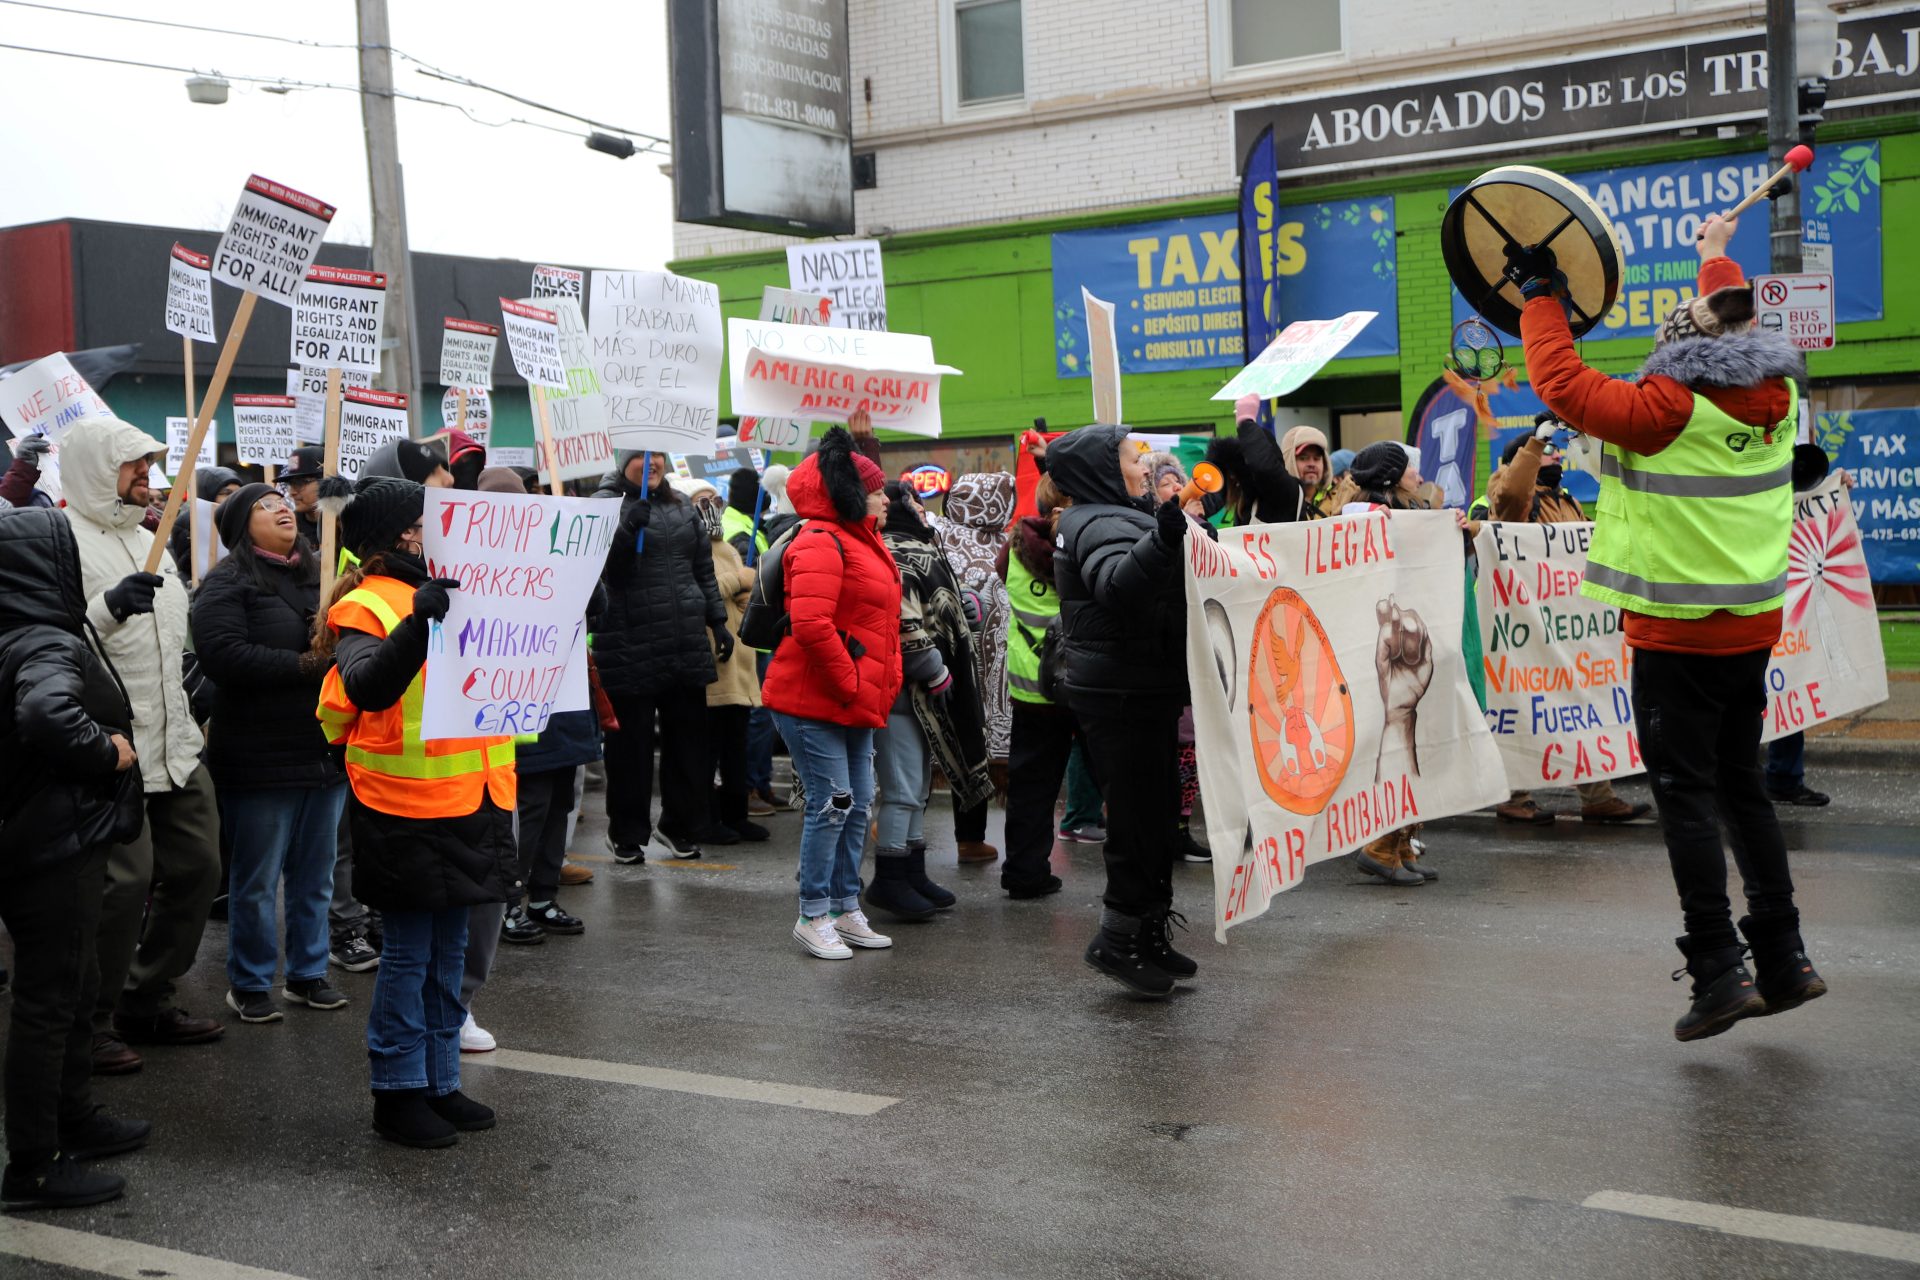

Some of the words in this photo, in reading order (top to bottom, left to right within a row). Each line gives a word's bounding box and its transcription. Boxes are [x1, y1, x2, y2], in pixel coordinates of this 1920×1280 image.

[786, 10, 832, 39] EXTRAS
[769, 28, 829, 59] PAGADAS
[733, 52, 842, 94] DISCRIMINACION
[1300, 81, 1546, 151] ABOGADOS
[1562, 80, 1612, 111] DE
[1620, 70, 1687, 104] LOS
[1703, 27, 1920, 97] TRBAJ
[742, 91, 836, 130] 773-831-8000
[1582, 164, 1769, 218] ANGLISH
[237, 203, 318, 244] IMMIGRANT
[230, 222, 278, 250] RIGHTS
[281, 242, 309, 261] AND
[224, 238, 303, 275] LEGALIZATION
[801, 248, 878, 283] NADIE
[1128, 221, 1307, 289] TAXS
[218, 253, 255, 281] FOR
[258, 270, 297, 297] ALL!
[319, 270, 335, 278] WITH
[336, 271, 372, 283] PALESTINE
[534, 266, 560, 277] FIGHT
[561, 271, 581, 281] FOR
[534, 274, 580, 292] MLK'S
[1654, 260, 1698, 282] FAMIL
[169, 283, 190, 300] RIGHTS
[193, 293, 208, 305] AND
[604, 274, 636, 299] MI
[1143, 289, 1195, 312] SERVICIO
[1198, 286, 1241, 306] ELECTR
[168, 297, 209, 318] LEGALIZATION
[296, 292, 378, 314] IMMIGRANT
[1789, 310, 1819, 322] BUS
[168, 310, 186, 328] FOR
[189, 317, 211, 335] ALL!
[296, 310, 343, 327] RIGHTS
[348, 317, 377, 331] AND
[612, 304, 698, 334] TRABAJA
[1144, 312, 1200, 336] DEPÓSITO
[1202, 310, 1242, 331] DIRECT
[1790, 323, 1827, 335] STOP
[296, 326, 376, 345] LEGALIZATION
[444, 337, 491, 352] IMMIGRANT
[507, 321, 555, 344] IMMIGRANT
[746, 329, 784, 350] NO
[803, 334, 867, 356] ONE
[295, 340, 330, 360] FOR
[337, 345, 375, 365] ALL!
[443, 349, 471, 360] RIGHTS
[473, 354, 489, 363] AND
[509, 336, 537, 352] RIGHTS
[539, 345, 557, 357] AND
[512, 349, 560, 368] LEGALIZATION
[593, 330, 636, 357] MÁS
[649, 339, 699, 364] DURO
[1145, 339, 1205, 361] CONSULTA
[1208, 338, 1216, 356] Y
[303, 367, 368, 382] LEGAATION
[442, 359, 489, 372] LEGALIZATION
[442, 369, 462, 383] FOR
[466, 372, 488, 385] ALL!
[516, 360, 535, 378] FOR
[539, 367, 563, 384] ALL!
[603, 361, 647, 388] QUE
[659, 367, 687, 389] EL
[749, 358, 854, 393] AMERICA
[863, 376, 929, 404] GREAT
[17, 389, 52, 423] WE
[55, 401, 87, 429] HAVE
[444, 398, 486, 410] DEORT
[552, 398, 579, 431] NOT
[237, 414, 293, 425] IMMIGRANT
[238, 426, 271, 435] RIGHTS
[275, 427, 293, 436] AND
[343, 412, 403, 432] IMMIGRANT
[754, 416, 800, 446] KIDS
[239, 437, 293, 446] LEGALIZATION
[341, 444, 376, 456] LEGALIZ
[342, 431, 377, 444] RIGHTS
[1859, 433, 1907, 458] TAX
[240, 446, 265, 459] FOR
[1871, 494, 1920, 522] MÁS
[439, 500, 543, 553] TRUMP
[549, 509, 620, 558] LATIN
[1492, 523, 1527, 561] EL
[1541, 523, 1596, 559] PUE
[1242, 532, 1278, 580] ES
[1304, 515, 1395, 577] ILEGAL
[428, 557, 555, 601] WORKERS
[1492, 567, 1530, 608] NO
[458, 616, 558, 658] MAKING
[1490, 612, 1530, 652] NO
[1539, 605, 1617, 645] REDAD
[1575, 651, 1618, 689] SER
[474, 700, 556, 735] GREA
[1531, 695, 1603, 735] FUERA
[1326, 773, 1419, 853] ROBADA
[1224, 860, 1256, 922] EN
